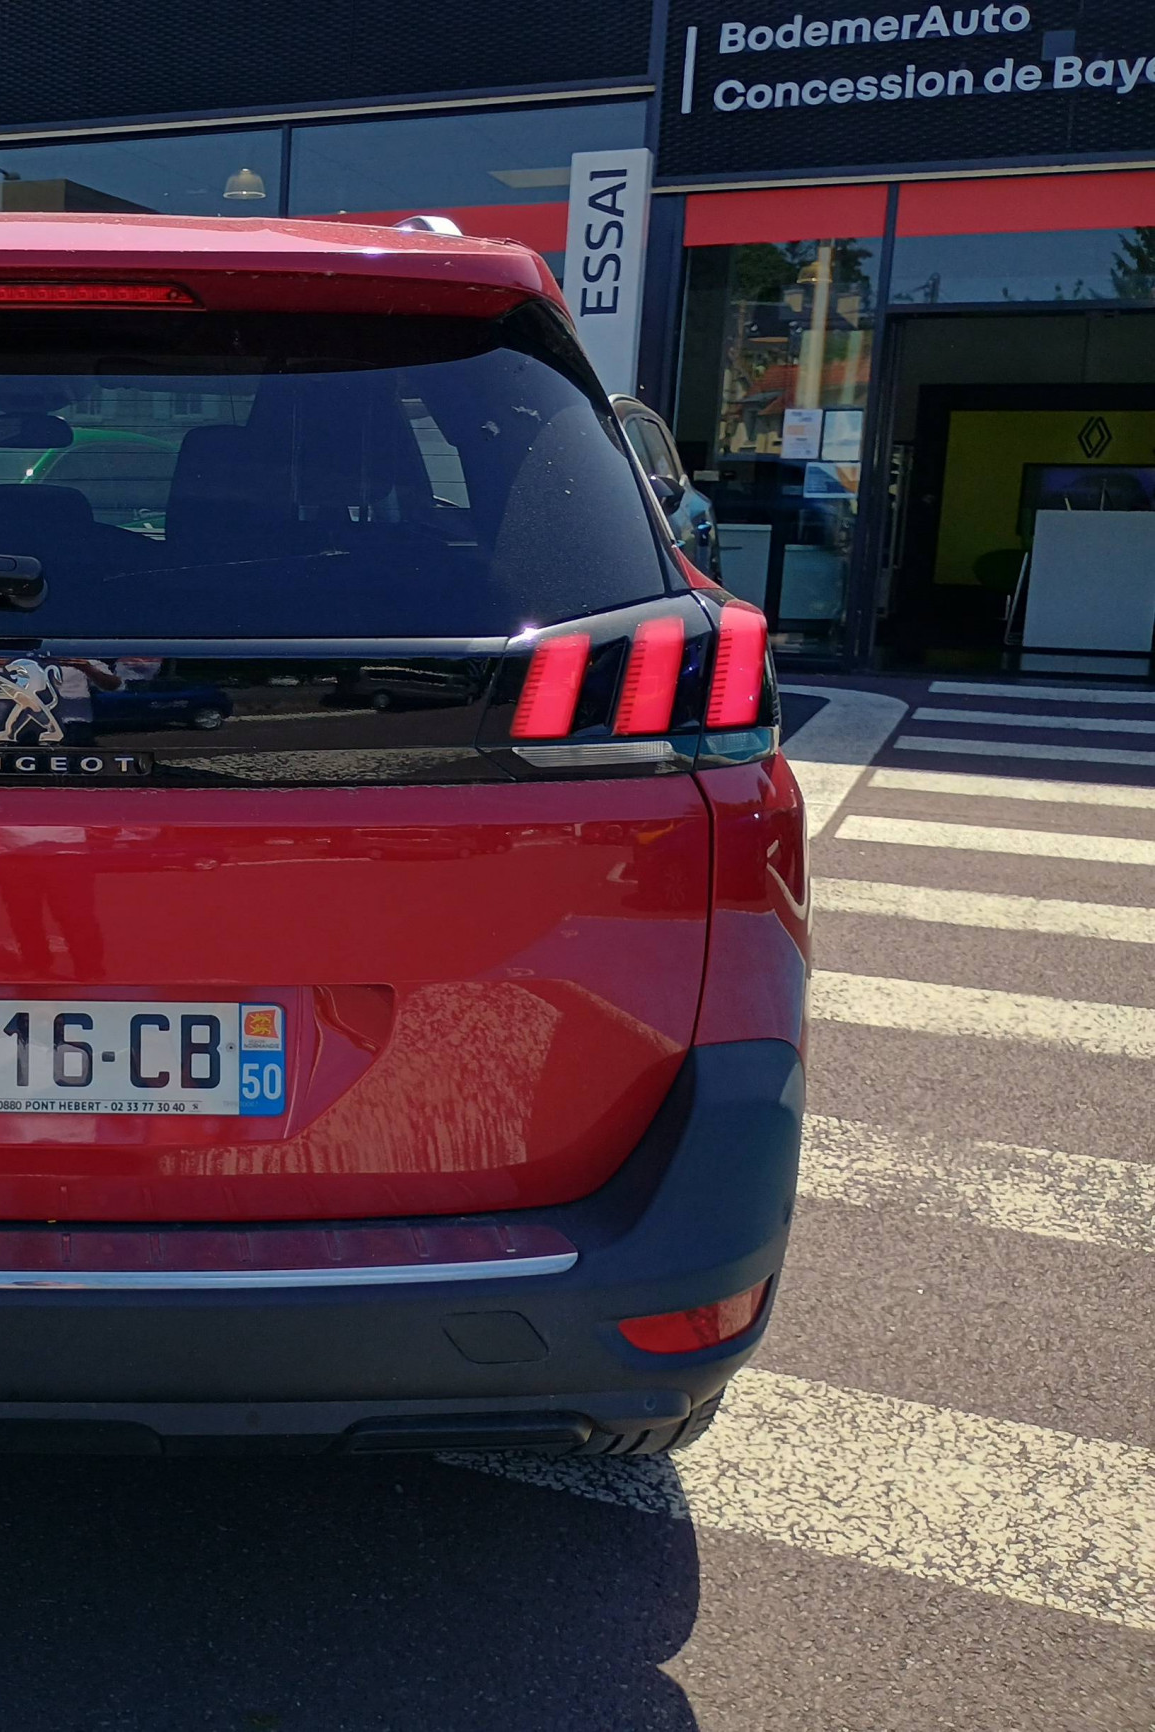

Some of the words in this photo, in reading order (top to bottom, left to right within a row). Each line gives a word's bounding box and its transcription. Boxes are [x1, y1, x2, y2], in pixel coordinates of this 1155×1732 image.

[719, 4, 1031, 53] BodemerAuto
[713, 64, 974, 111] Concession
[984, 58, 1042, 91] de
[580, 169, 627, 317] ESSAI
[242, 1063, 282, 1100] 50
[25, 1101, 54, 1111] PONT
[58, 1101, 101, 1111] HEBERT
[110, 1102, 124, 1112] 02
[127, 1102, 138, 1112] 33
[142, 1102, 154, 1112] 77
[157, 1103, 170, 1112] 30
[172, 1103, 186, 1112] 40
